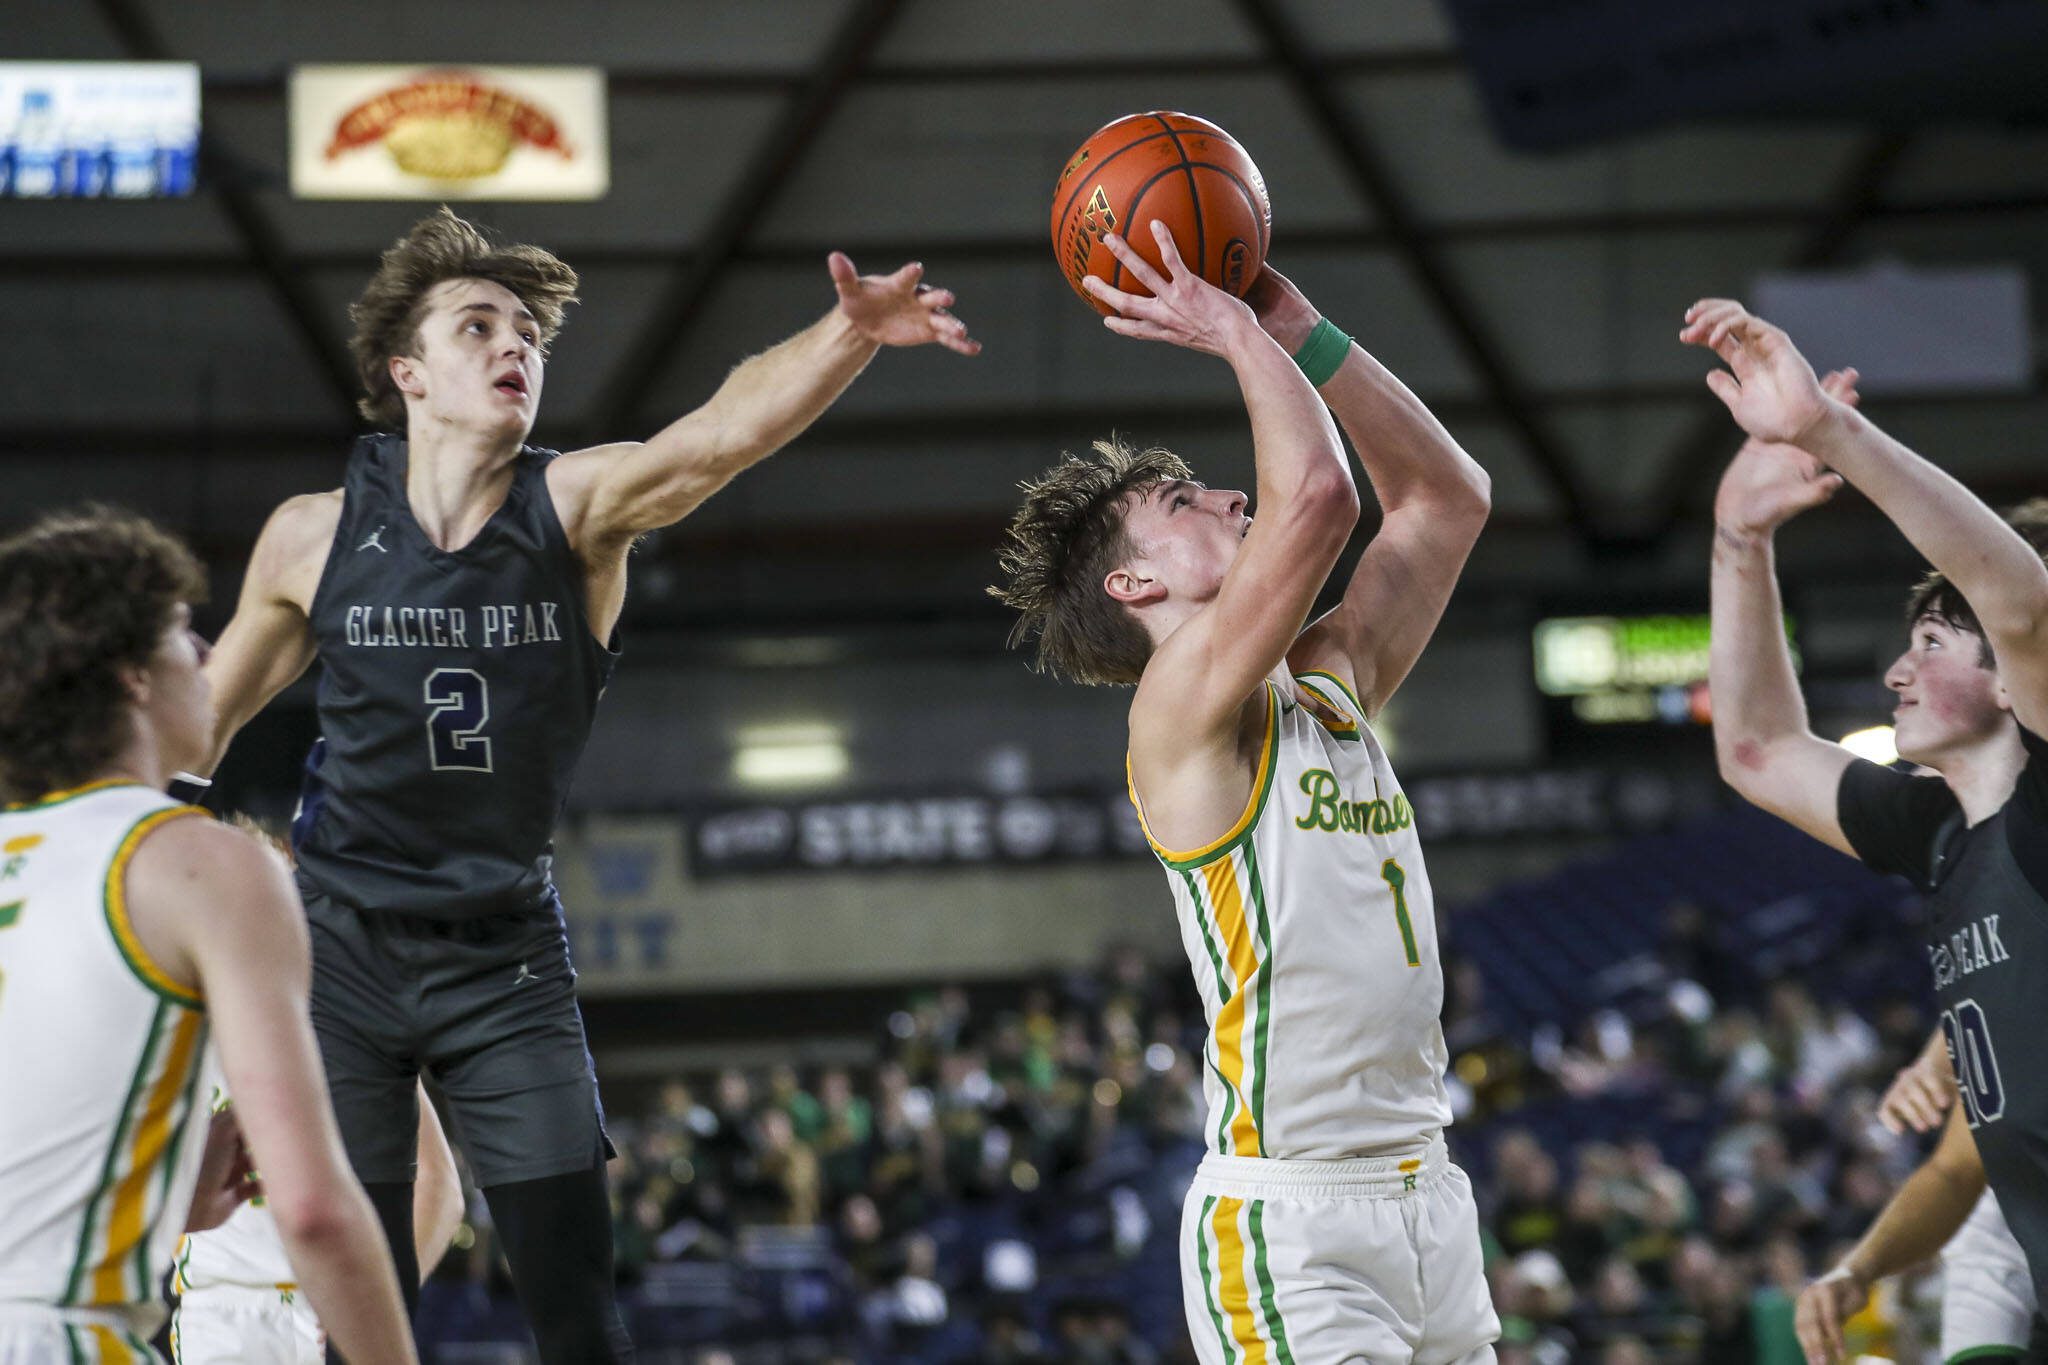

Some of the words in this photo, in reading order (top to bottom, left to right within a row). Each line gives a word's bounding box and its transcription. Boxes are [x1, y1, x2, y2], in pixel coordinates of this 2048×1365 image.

[344, 605, 469, 648] GLACIER
[481, 601, 562, 648] PEAK
[423, 667, 494, 774] 2
[800, 798, 993, 866] STATE
[1381, 858, 1422, 967] 1
